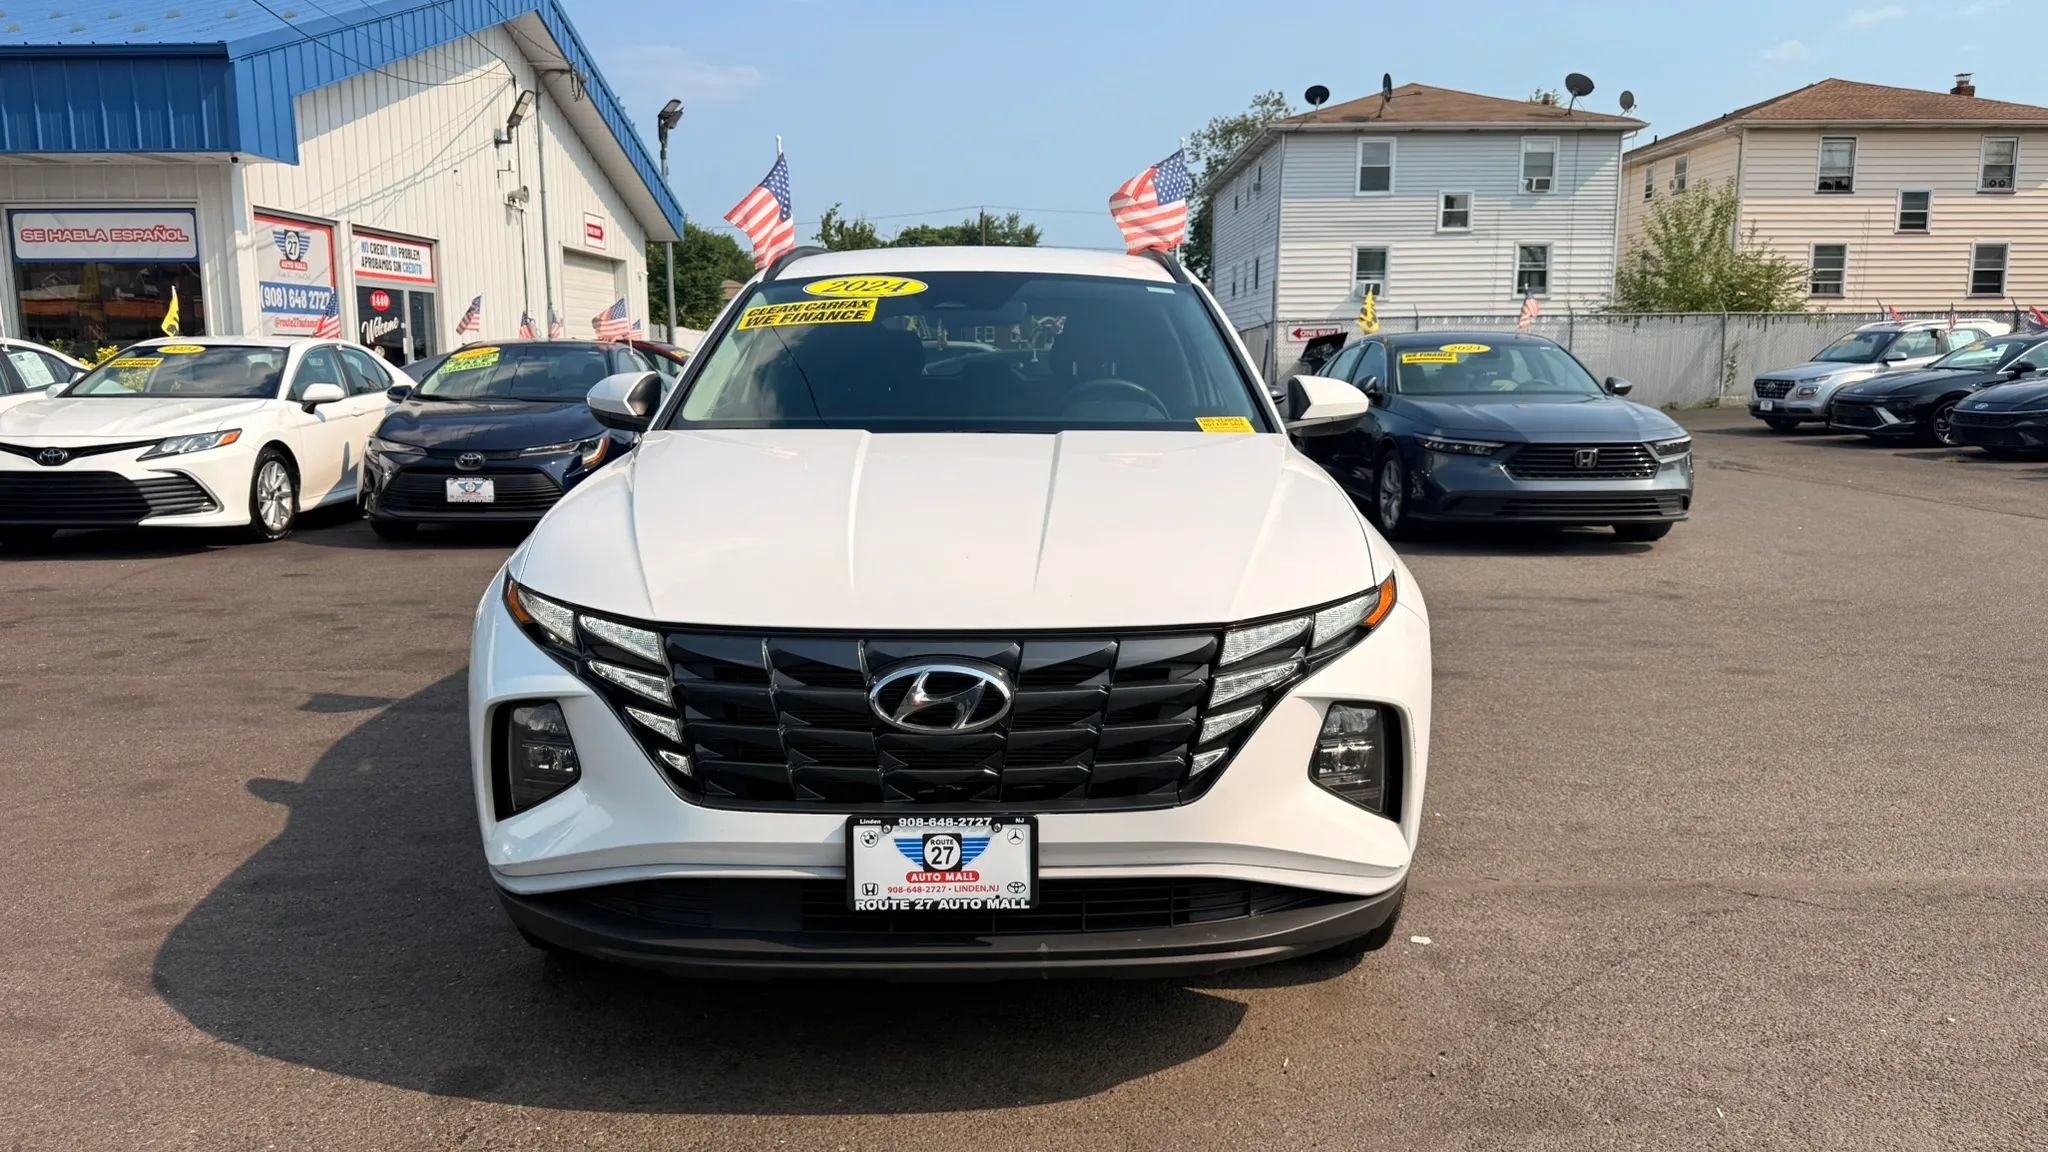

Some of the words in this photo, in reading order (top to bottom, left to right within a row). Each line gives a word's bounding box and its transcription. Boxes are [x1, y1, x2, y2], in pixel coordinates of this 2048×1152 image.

[21, 229, 45, 242] SE
[48, 229, 108, 242] HABLA
[110, 225, 189, 242] ESPAÑOL
[287, 240, 298, 256] 27
[361, 240, 369, 253] NO
[369, 243, 390, 258] CREDIT,
[398, 247, 421, 262] PROBLEM
[361, 256, 393, 272] APROBAMOS
[393, 261, 402, 272] SIN
[823, 280, 907, 293] 2024
[260, 285, 287, 309] (908)
[288, 289, 307, 309] 648
[308, 290, 330, 310] 2727
[748, 305, 801, 317] CLEAN
[805, 300, 873, 310] CARFAX
[745, 315, 777, 327] WE
[780, 309, 868, 324] FINANCE
[361, 316, 400, 344] Welcome
[1300, 329, 1316, 337] ONE
[898, 817, 992, 827] 908-648-2727
[931, 846, 954, 865] 27
[911, 873, 941, 882] AUTO
[945, 873, 975, 881] MALL
[954, 885, 1000, 893] LINDEN,NJ
[855, 900, 910, 910] ROUTE
[914, 900, 933, 910] 27
[937, 899, 982, 910] AUTO
[986, 898, 1030, 909] MALL
